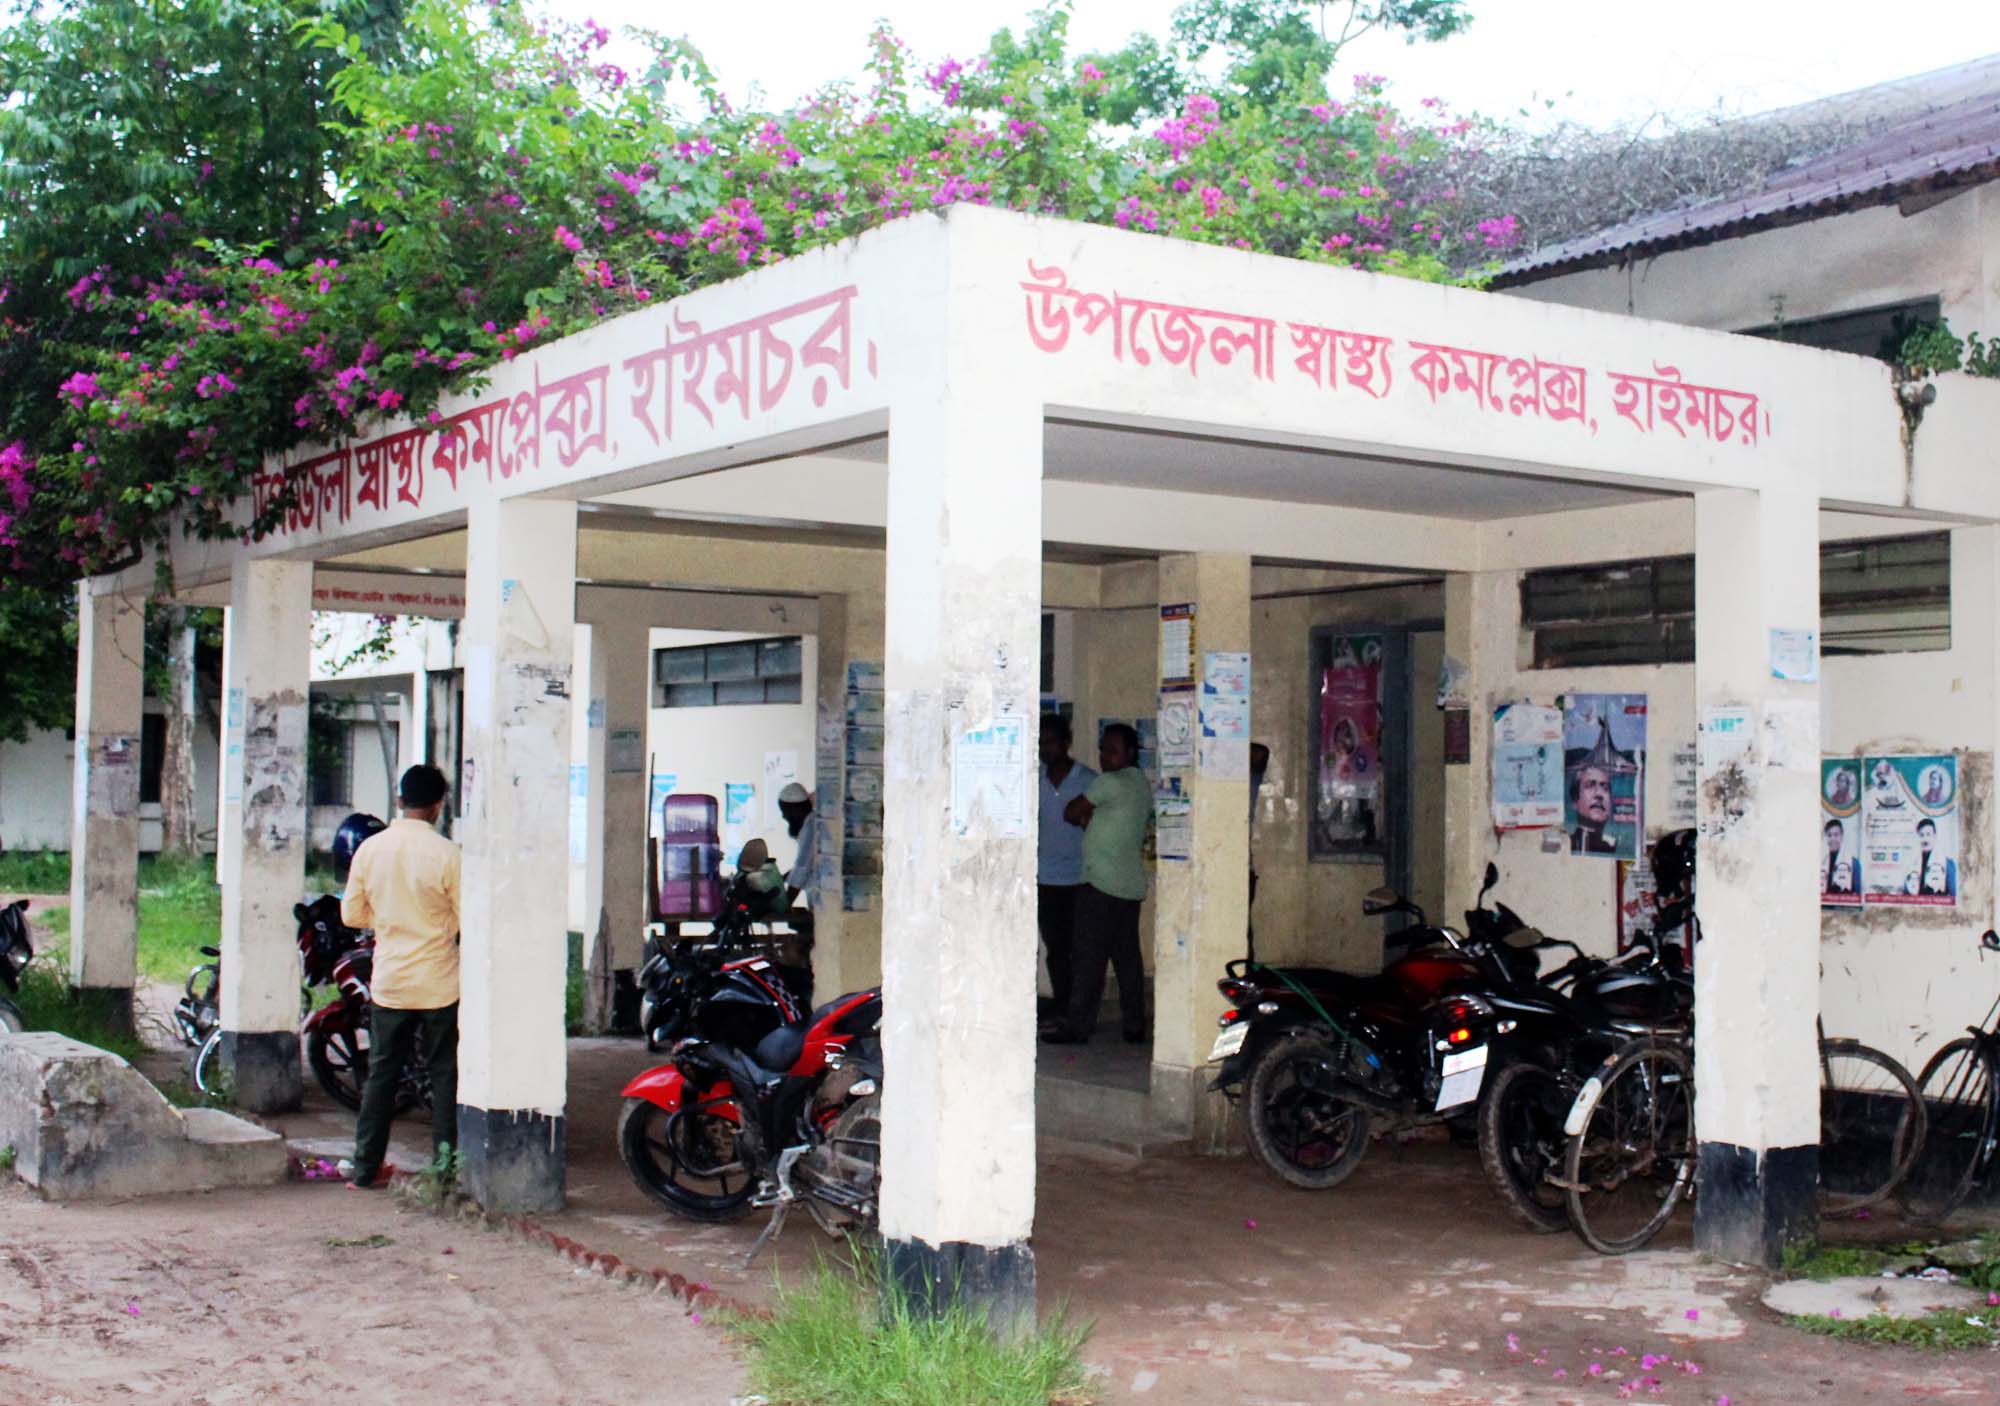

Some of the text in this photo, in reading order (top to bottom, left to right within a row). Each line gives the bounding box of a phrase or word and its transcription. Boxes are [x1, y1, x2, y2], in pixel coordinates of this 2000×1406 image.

[1019, 257, 1278, 383] উপজেলা
[1286, 322, 1394, 400] স্বাস্থ্য
[1408, 340, 1599, 435] কমপ্লেক্স,
[354, 428, 425, 511] স্বাস্থ্য
